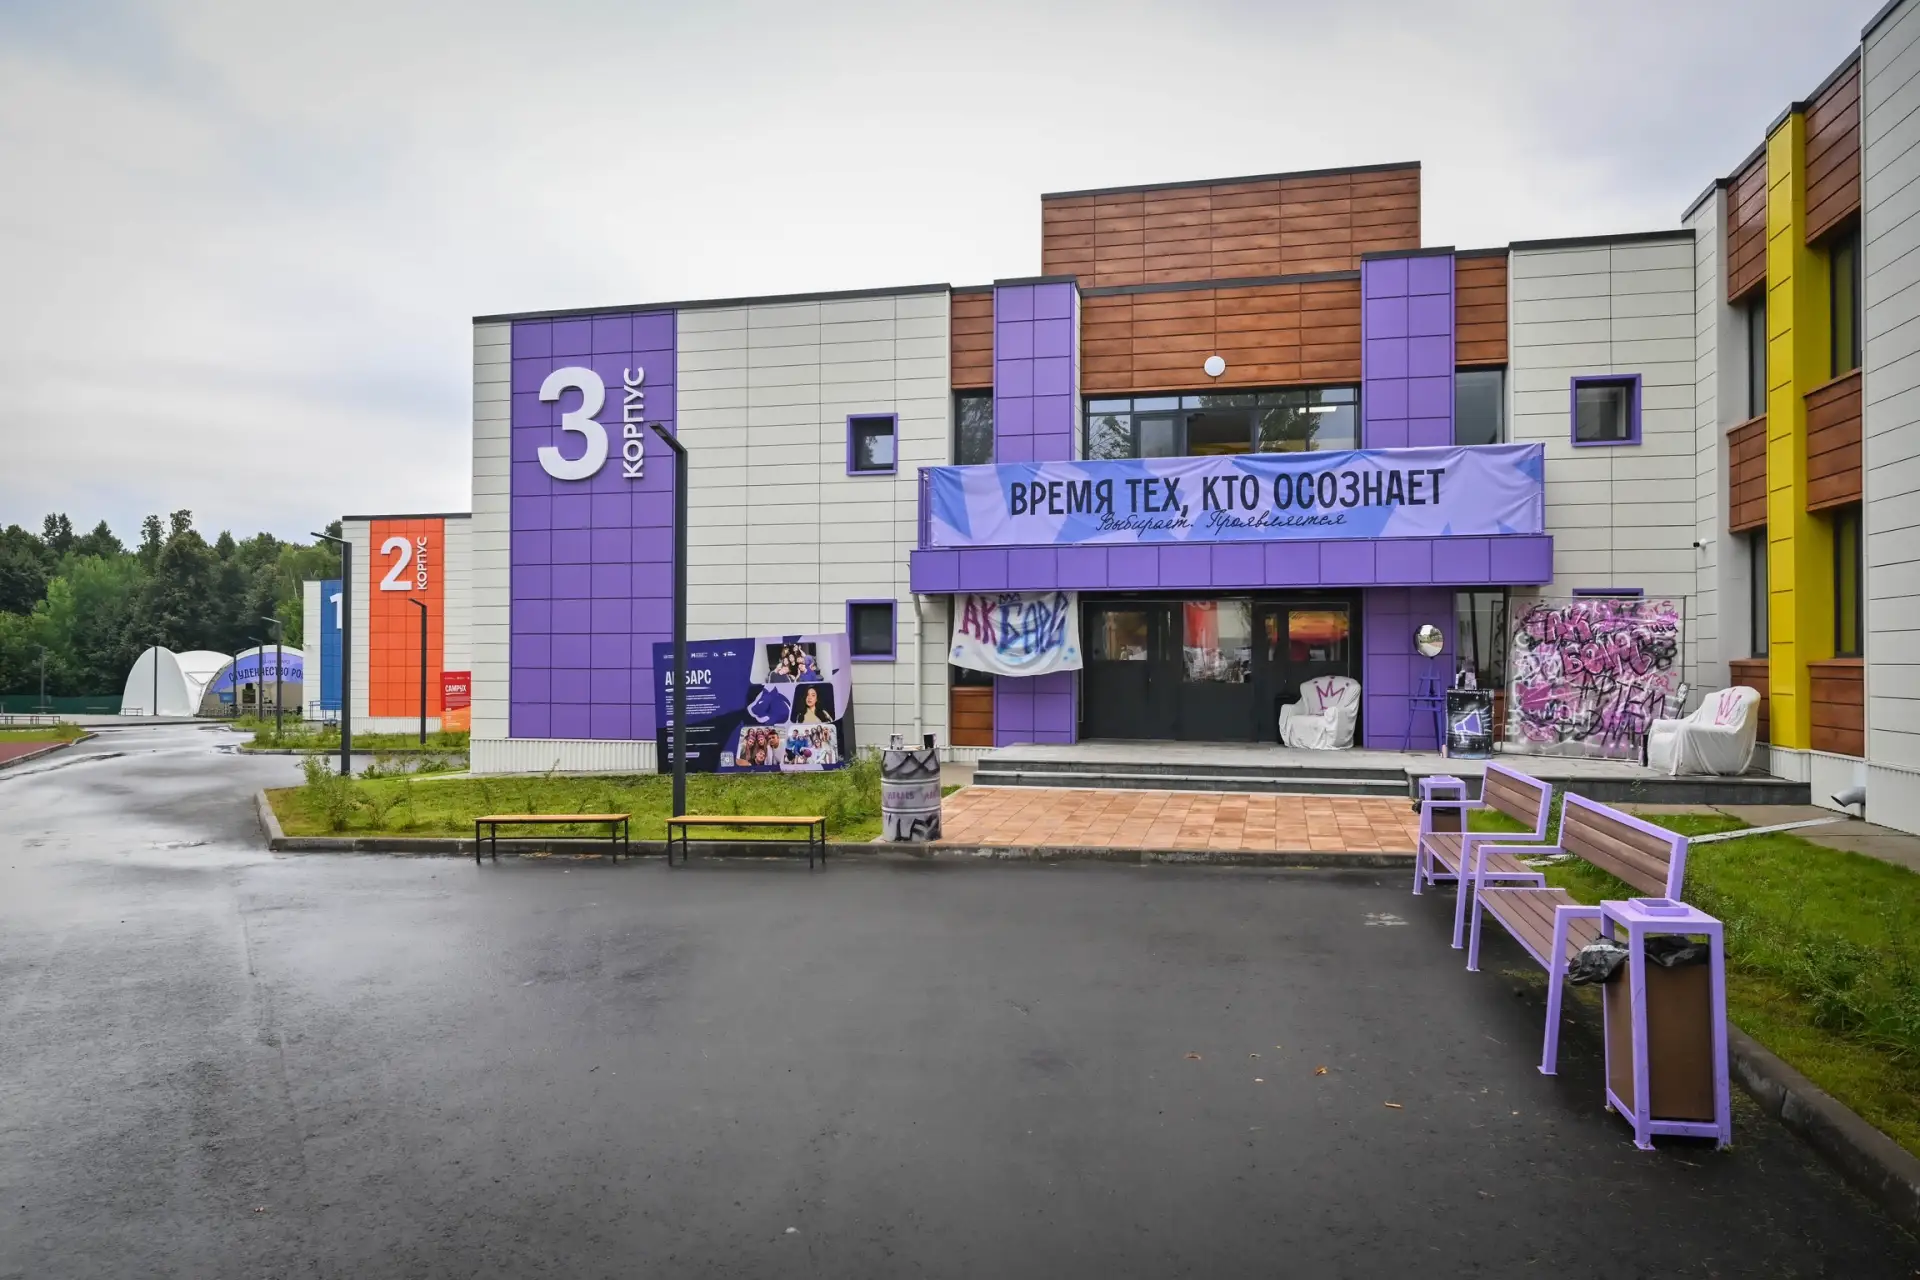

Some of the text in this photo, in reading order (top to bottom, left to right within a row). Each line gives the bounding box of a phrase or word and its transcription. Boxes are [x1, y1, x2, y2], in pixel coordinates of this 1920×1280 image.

[538, 366, 608, 480] 3
[623, 367, 644, 478] КОРПУС
[1011, 468, 1445, 517] ВРЕМЯ ТЕХ, КТО ОСОЗНАЕТ
[1096, 509, 1347, 537] Выбирает. Проявляется
[380, 536, 412, 590] 2
[416, 536, 427, 590] КОРПУС
[329, 592, 343, 629] 1
[959, 594, 997, 646] АК
[291, 668, 303, 680] РО
